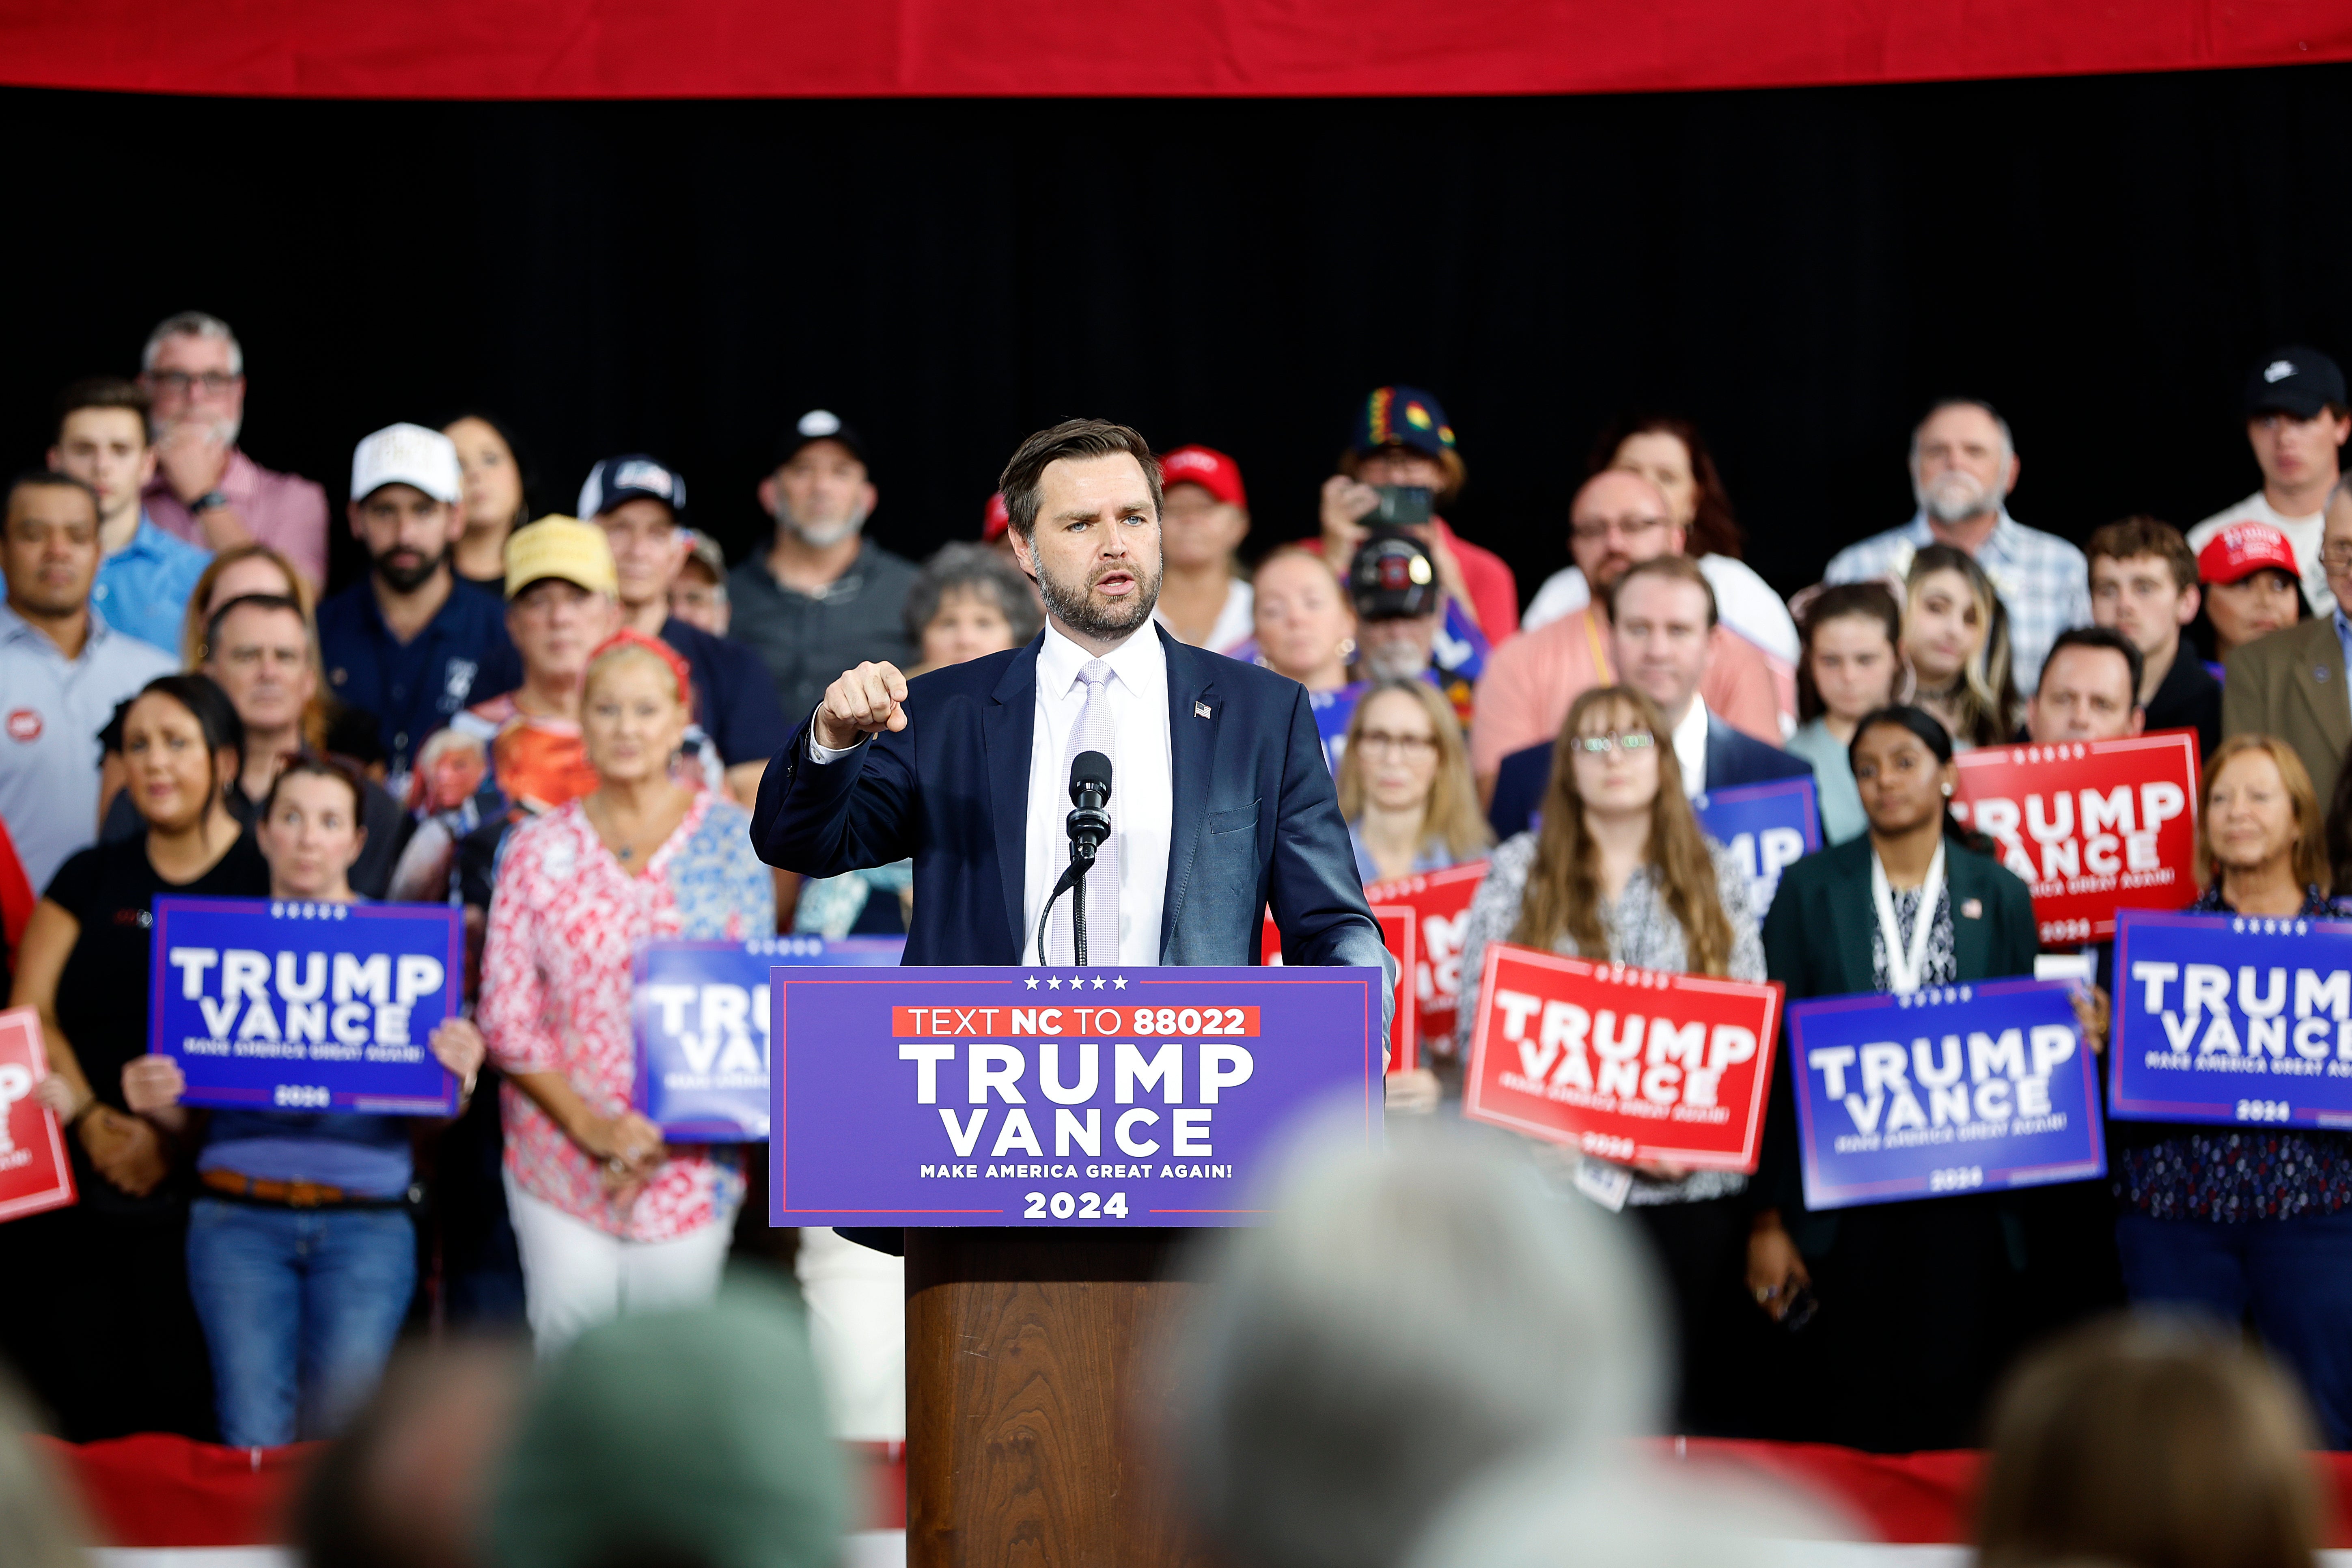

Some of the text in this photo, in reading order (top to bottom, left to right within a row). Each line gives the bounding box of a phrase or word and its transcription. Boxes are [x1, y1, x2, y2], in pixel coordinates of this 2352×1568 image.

[1950, 781, 2185, 845] RUMP
[2003, 830, 2160, 886] ANCE
[170, 947, 444, 1008] TRUMP
[2132, 960, 2351, 1022] TRUM
[199, 996, 411, 1046] VANCE
[908, 1008, 1246, 1036] TEXT NC TO 88022
[1495, 988, 1756, 1074] TRUMP
[898, 1044, 1255, 1105] TRUMP
[1518, 1038, 1723, 1108] VANCE
[1808, 1024, 2076, 1100] TRUMP
[938, 1107, 1213, 1158] VANCE
[1843, 1074, 2052, 1136] VANCE
[2236, 1098, 2290, 1124] 2024
[920, 1164, 1233, 1179] MAKE AMERICA GREAT AGAIN!
[1023, 1191, 1129, 1219] 2024
